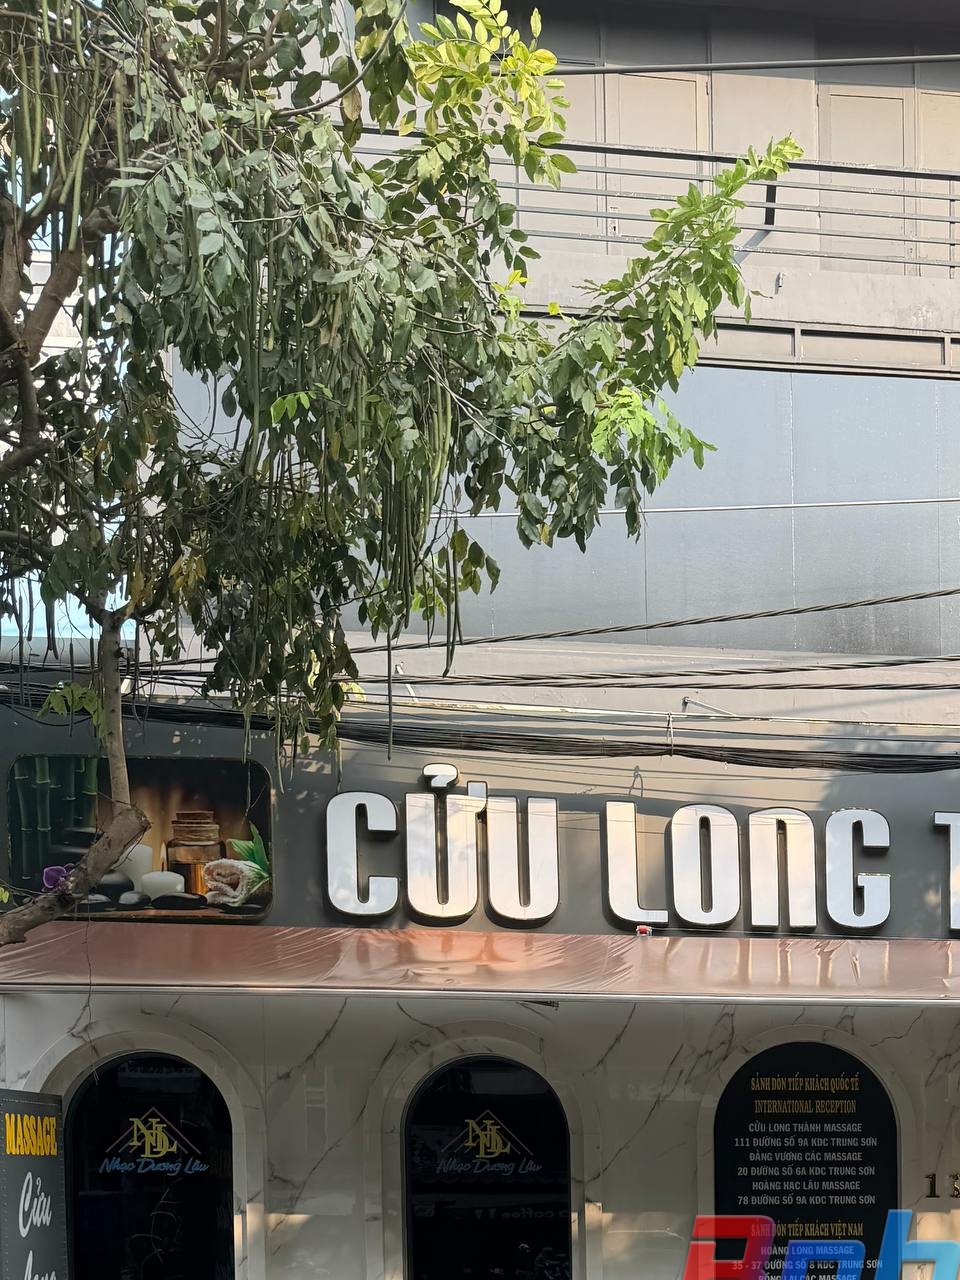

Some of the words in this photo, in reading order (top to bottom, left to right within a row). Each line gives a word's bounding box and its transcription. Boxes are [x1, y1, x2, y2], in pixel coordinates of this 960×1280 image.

[326, 763, 561, 920] CỬU
[604, 800, 893, 930] LONG
[755, 1099, 813, 1113] INTERNATIONAL
[815, 1099, 857, 1113] RECEPTION
[749, 1120, 766, 1132] CỬU
[769, 1123, 790, 1132] LONG
[793, 1121, 821, 1132] THÀNH
[824, 1123, 863, 1132] MASSAGE
[5, 1112, 57, 1157] MASSAGE
[735, 1138, 750, 1147] 111
[752, 1135, 782, 1147] ĐƯỜNG
[784, 1134, 796, 1147] SỐ
[798, 1138, 809, 1147] 9A
[811, 1138, 828, 1147] KDC
[831, 1138, 859, 1147] TRUNG
[861, 1137, 878, 1147] SƠN
[824, 1152, 863, 1161] MASSAGE
[737, 1167, 748, 1176] 20
[751, 1164, 780, 1176] ĐƯỜNG
[782, 1163, 794, 1176] SỐ
[796, 1167, 806, 1176] 6A
[809, 1167, 826, 1176] KDC
[828, 1167, 856, 1176] TRUNG
[858, 1166, 875, 1176] SƠN
[737, 1196, 749, 1205] 78
[751, 1193, 780, 1205] ĐƯỜNG
[782, 1192, 794, 1205] SỐ
[796, 1196, 807, 1205] 9A
[809, 1196, 826, 1205] KDC
[829, 1196, 857, 1205] TRUNG
[859, 1195, 876, 1205] SƠN
[760, 1244, 789, 1255] HOÀNG
[792, 1246, 813, 1255] LONG
[816, 1246, 854, 1255] MASSAGE
